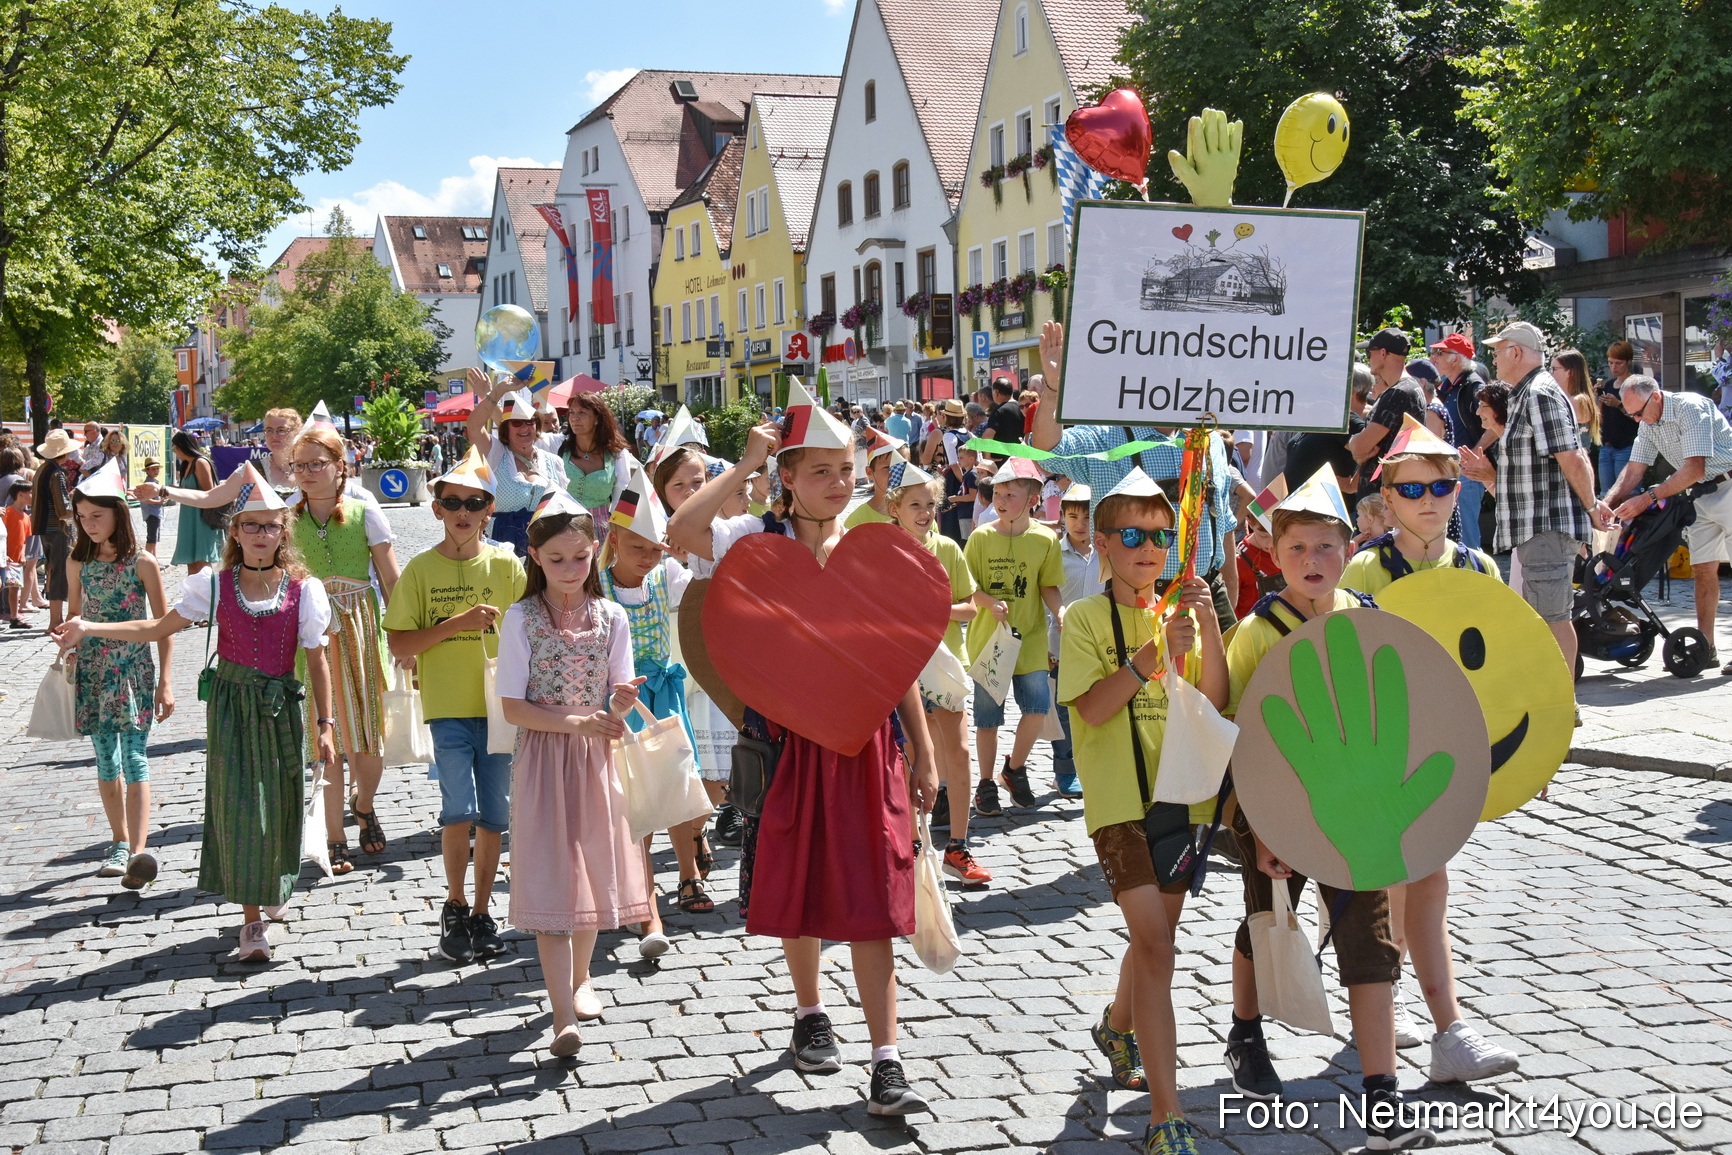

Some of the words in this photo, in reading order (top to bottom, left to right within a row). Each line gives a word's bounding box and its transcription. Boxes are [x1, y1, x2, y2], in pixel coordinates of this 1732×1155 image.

[592, 192, 606, 222] K&L
[684, 276, 703, 295] HOTEL
[976, 335, 986, 356] P
[1087, 319, 1328, 362] Grundschule
[1118, 376, 1294, 414] Holzheim
[431, 585, 474, 594] Grundschule
[1169, 863, 1178, 877] PRO
